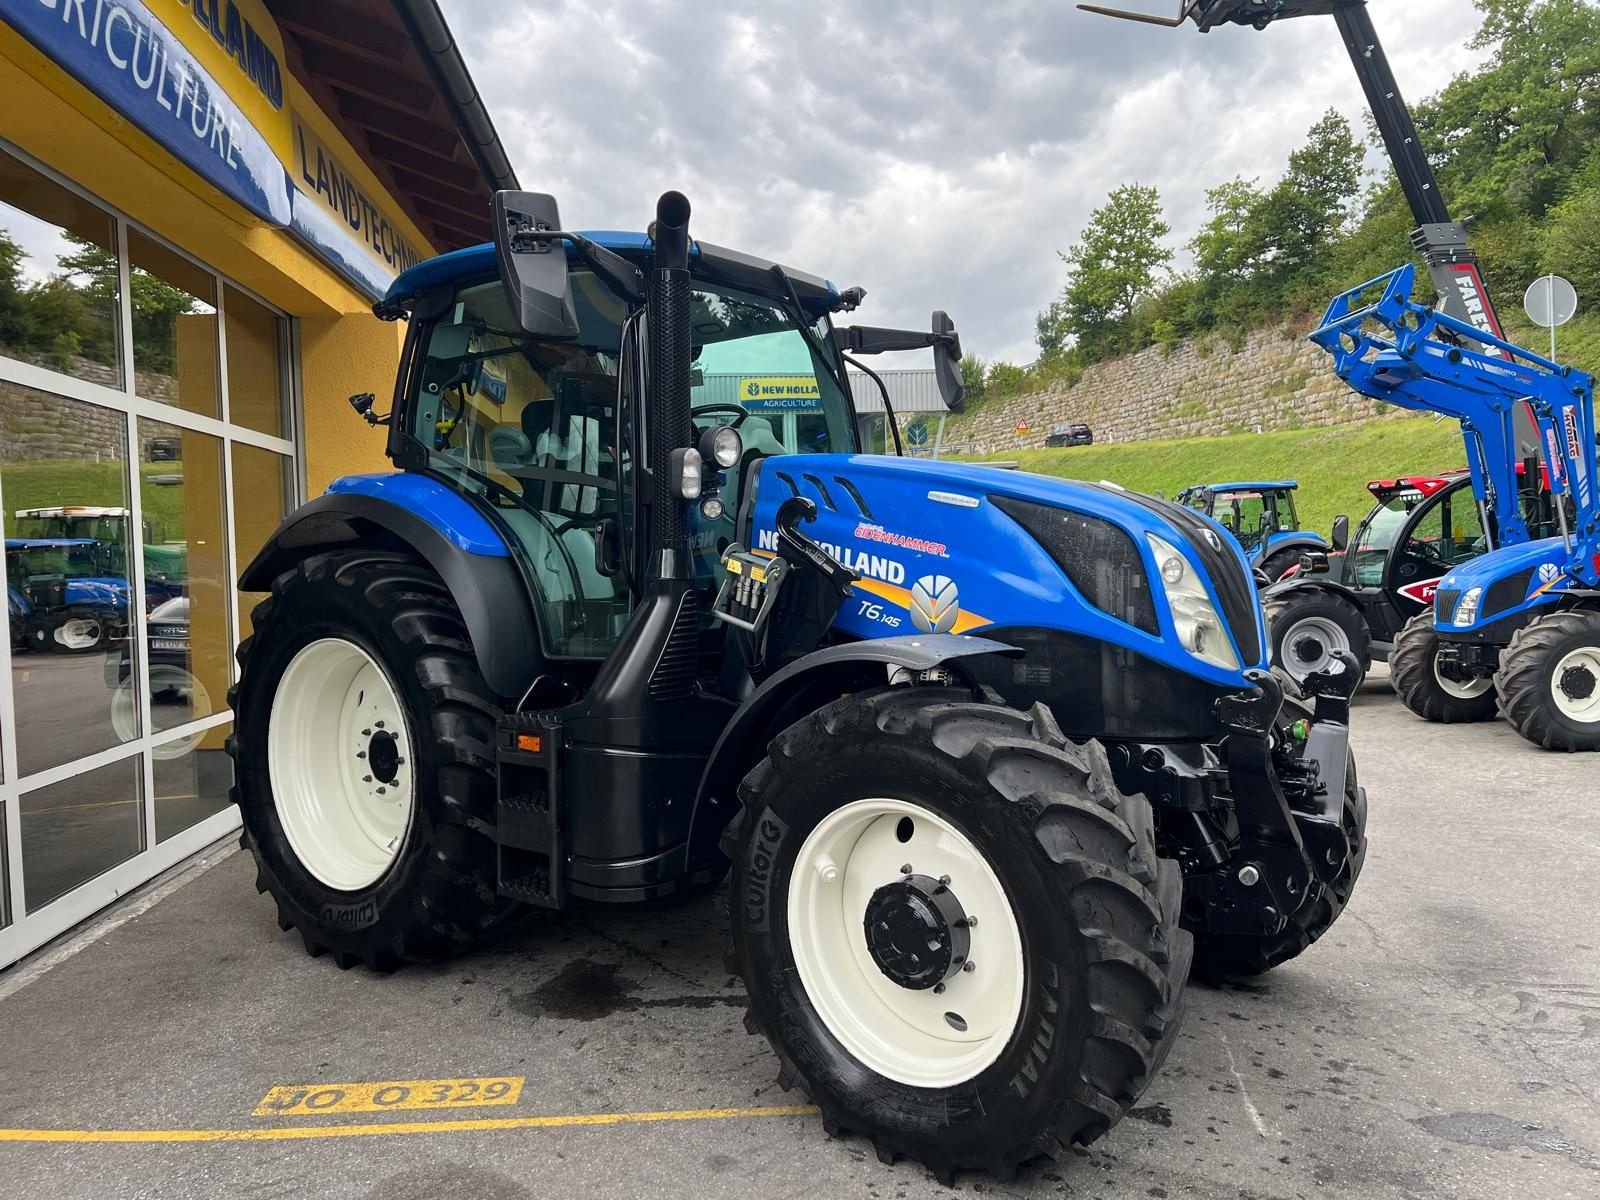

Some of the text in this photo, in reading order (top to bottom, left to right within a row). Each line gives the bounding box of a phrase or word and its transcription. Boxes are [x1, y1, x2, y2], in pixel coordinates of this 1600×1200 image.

[762, 386, 784, 394] NEW
[1564, 414, 1576, 457] HYDRAC
[854, 526, 947, 556] EIDENHAMMER
[814, 540, 905, 584] OLLAND
[858, 600, 902, 628] T6.145
[421, 1081, 512, 1103] 329
